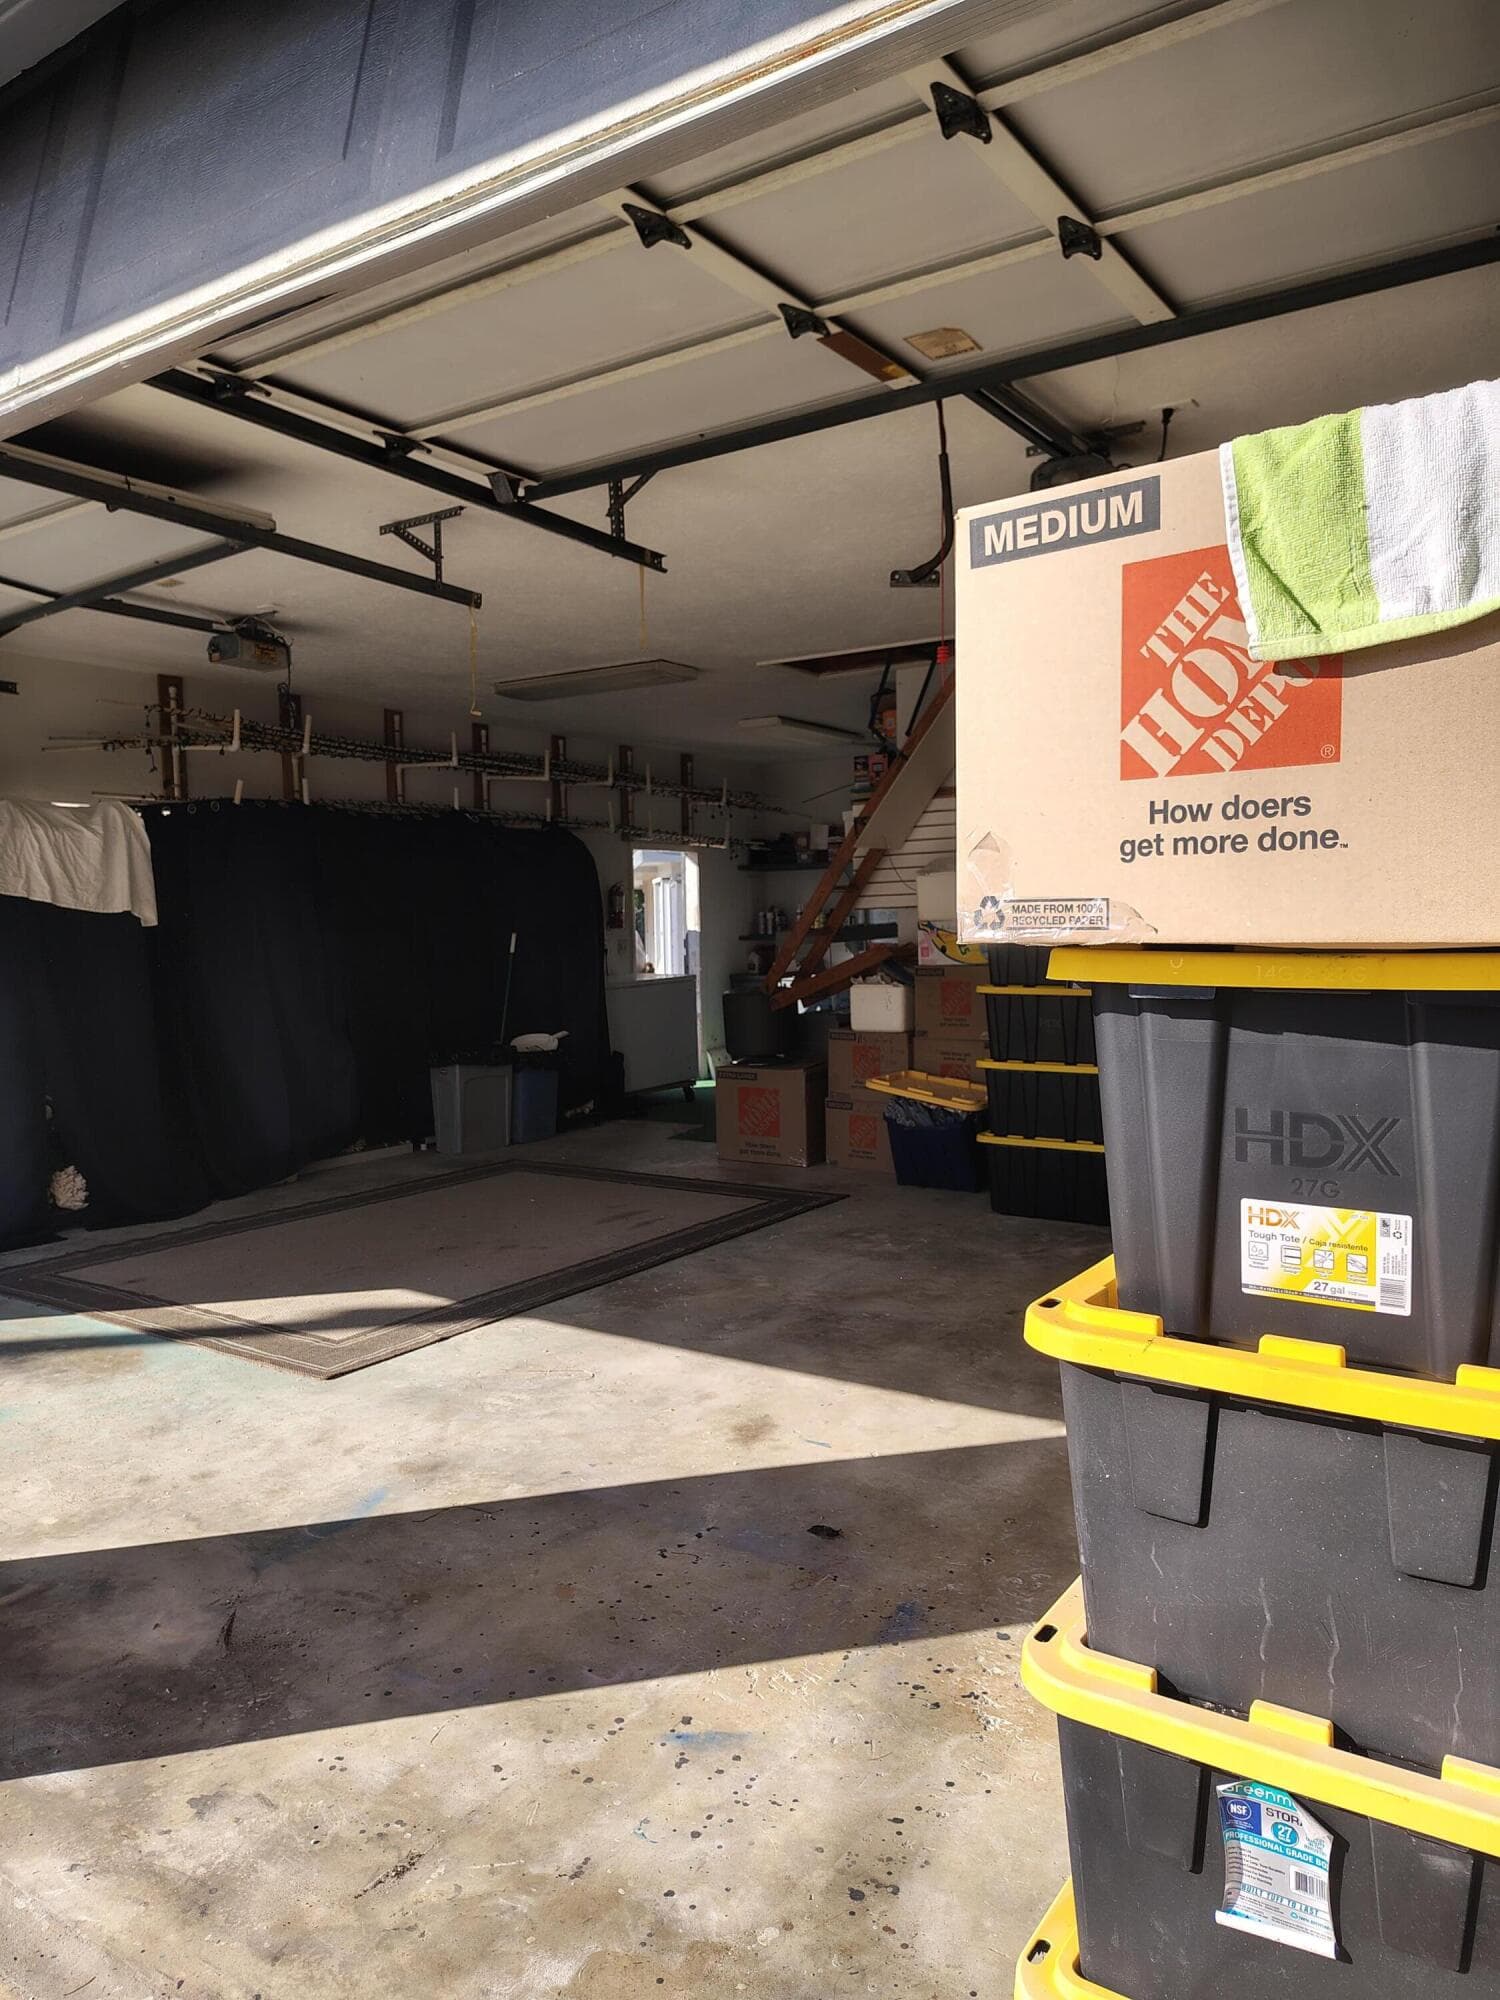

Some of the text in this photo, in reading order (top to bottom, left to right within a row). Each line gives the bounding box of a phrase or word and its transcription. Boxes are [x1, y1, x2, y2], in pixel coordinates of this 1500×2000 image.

[983, 490, 1143, 557] MEDIUM
[1140, 571, 1230, 668] THE
[1120, 597, 1264, 778] HOM
[1201, 658, 1322, 772] DEPO
[1149, 794, 1311, 824] How doers
[1120, 833, 1164, 863] get
[1173, 833, 1249, 855] more
[1012, 903, 1104, 914] MADE FROM 100%
[1012, 916, 1066, 926] RECYCLED
[1235, 1107, 1401, 1176] HDX
[1289, 1177, 1341, 1198] 27G
[1248, 1206, 1300, 1229] HDX
[1249, 1229, 1278, 1243] Tough
[1280, 1233, 1301, 1244] Tote
[1309, 1238, 1328, 1248] Caja
[1313, 1281, 1329, 1291] 27
[1330, 1285, 1345, 1295] gal
[1227, 1783, 1296, 1809] reenm
[1230, 1803, 1247, 1815] NSF
[1265, 1807, 1303, 1827] STOR
[1277, 1824, 1292, 1839] 27
[1225, 1832, 1285, 1854] PROFESSIONAL
[1285, 1847, 1314, 1863] GRADE
